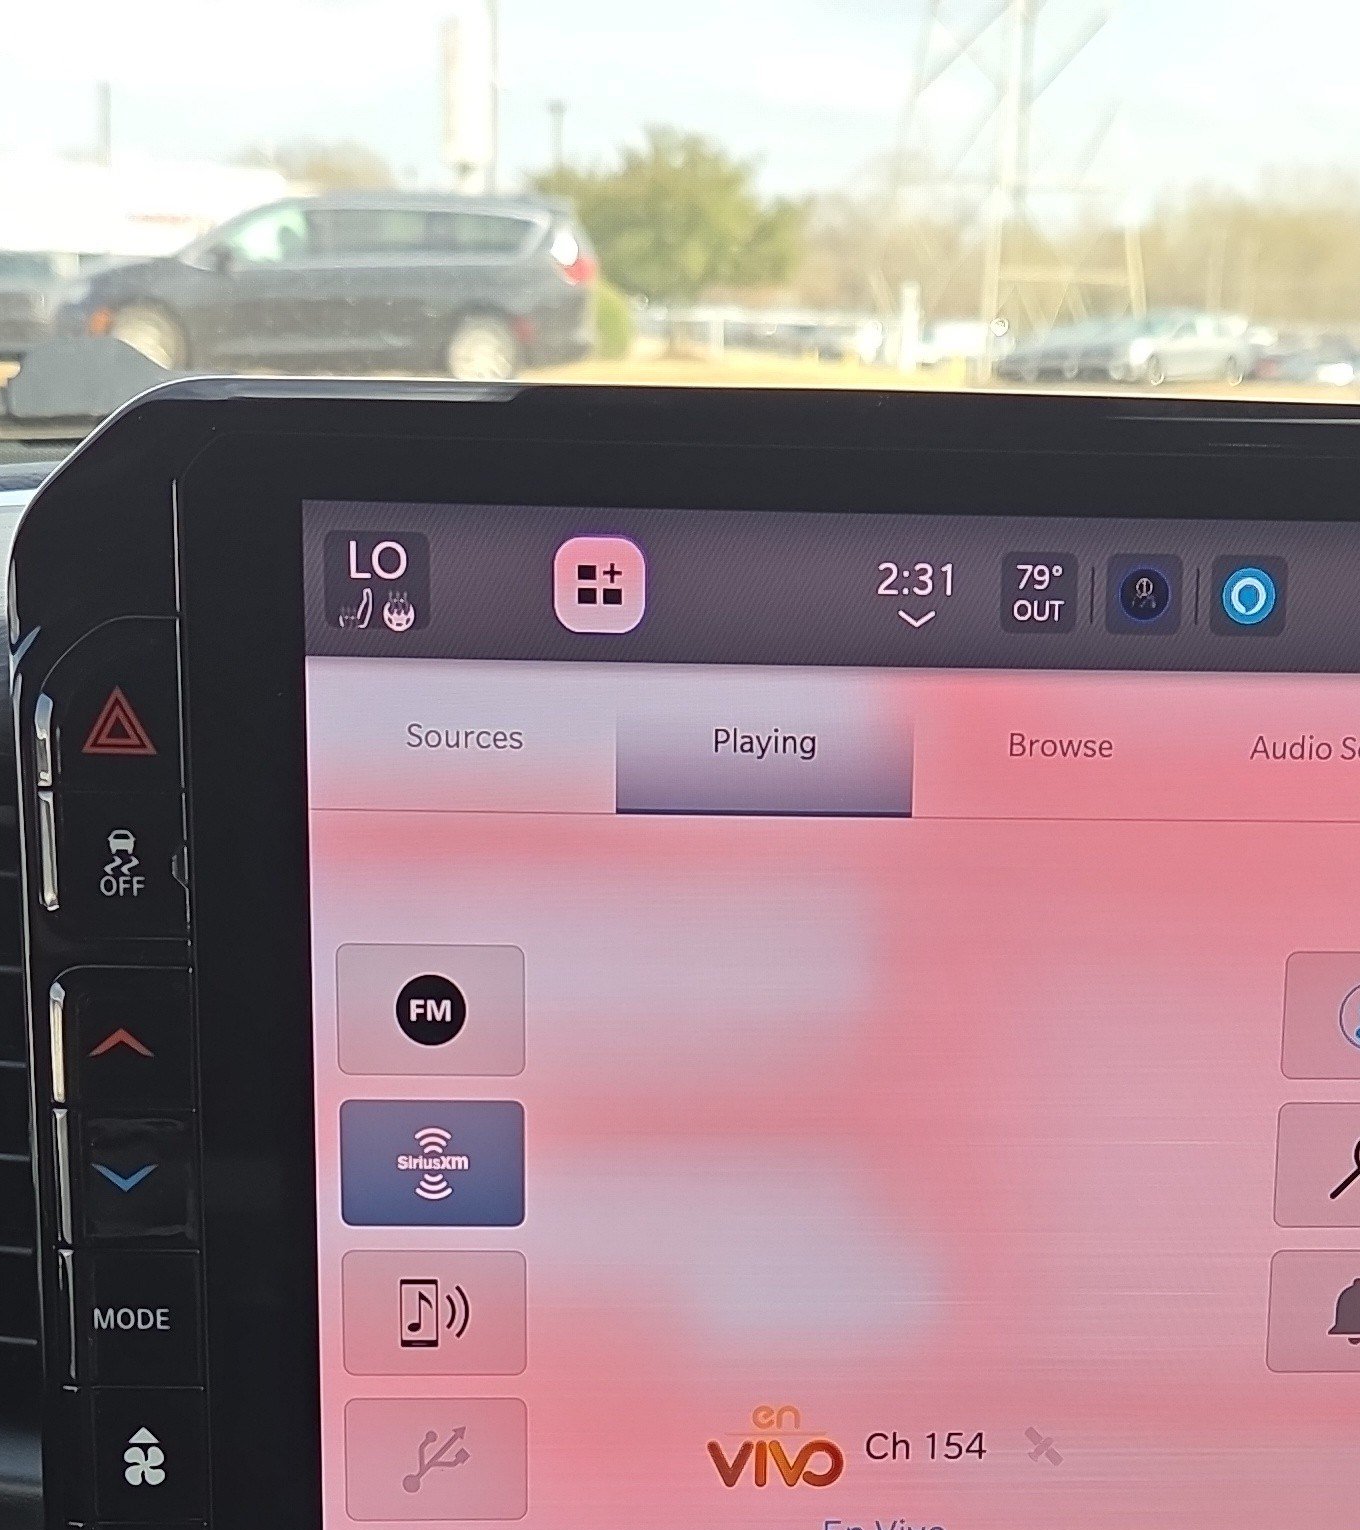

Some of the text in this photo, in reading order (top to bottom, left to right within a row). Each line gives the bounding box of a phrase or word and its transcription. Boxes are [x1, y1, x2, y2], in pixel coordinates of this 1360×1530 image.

[349, 540, 407, 580] LO
[877, 562, 954, 596] 2:31
[1013, 600, 1065, 623] OUT
[406, 723, 524, 750] Sources
[712, 727, 817, 760] Playing
[1008, 732, 1113, 759] Browse
[1250, 735, 1333, 761] Audio
[100, 875, 145, 897] OFF
[409, 998, 453, 1023] FM
[92, 1306, 171, 1332] MODE
[752, 1405, 801, 1429] en
[865, 1432, 987, 1460] Ch 154
